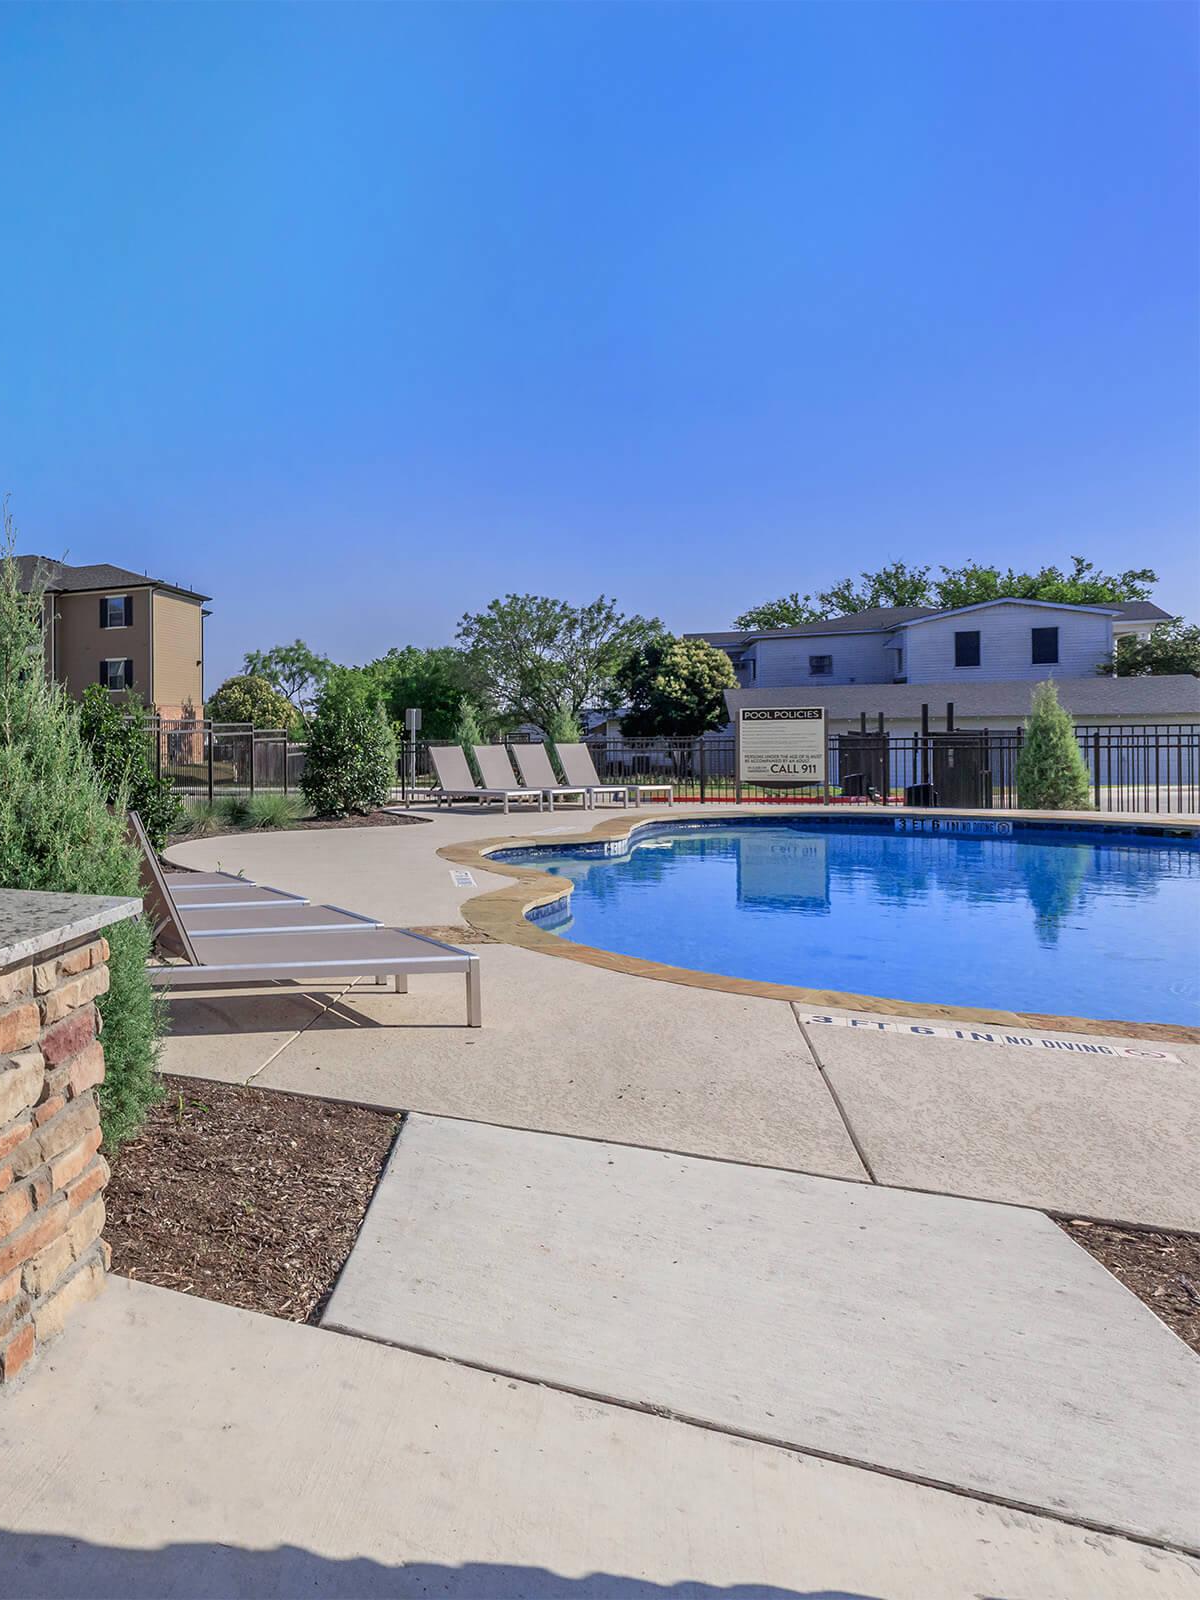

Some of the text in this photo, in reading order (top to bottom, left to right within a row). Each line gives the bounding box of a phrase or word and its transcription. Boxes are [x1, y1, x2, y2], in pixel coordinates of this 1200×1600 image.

[744, 710, 819, 719] POOL POLICIES
[770, 764, 799, 774] CALL
[801, 764, 817, 773] 911
[810, 1015, 1114, 1056] 3 FT 6 IN NO DIVING
